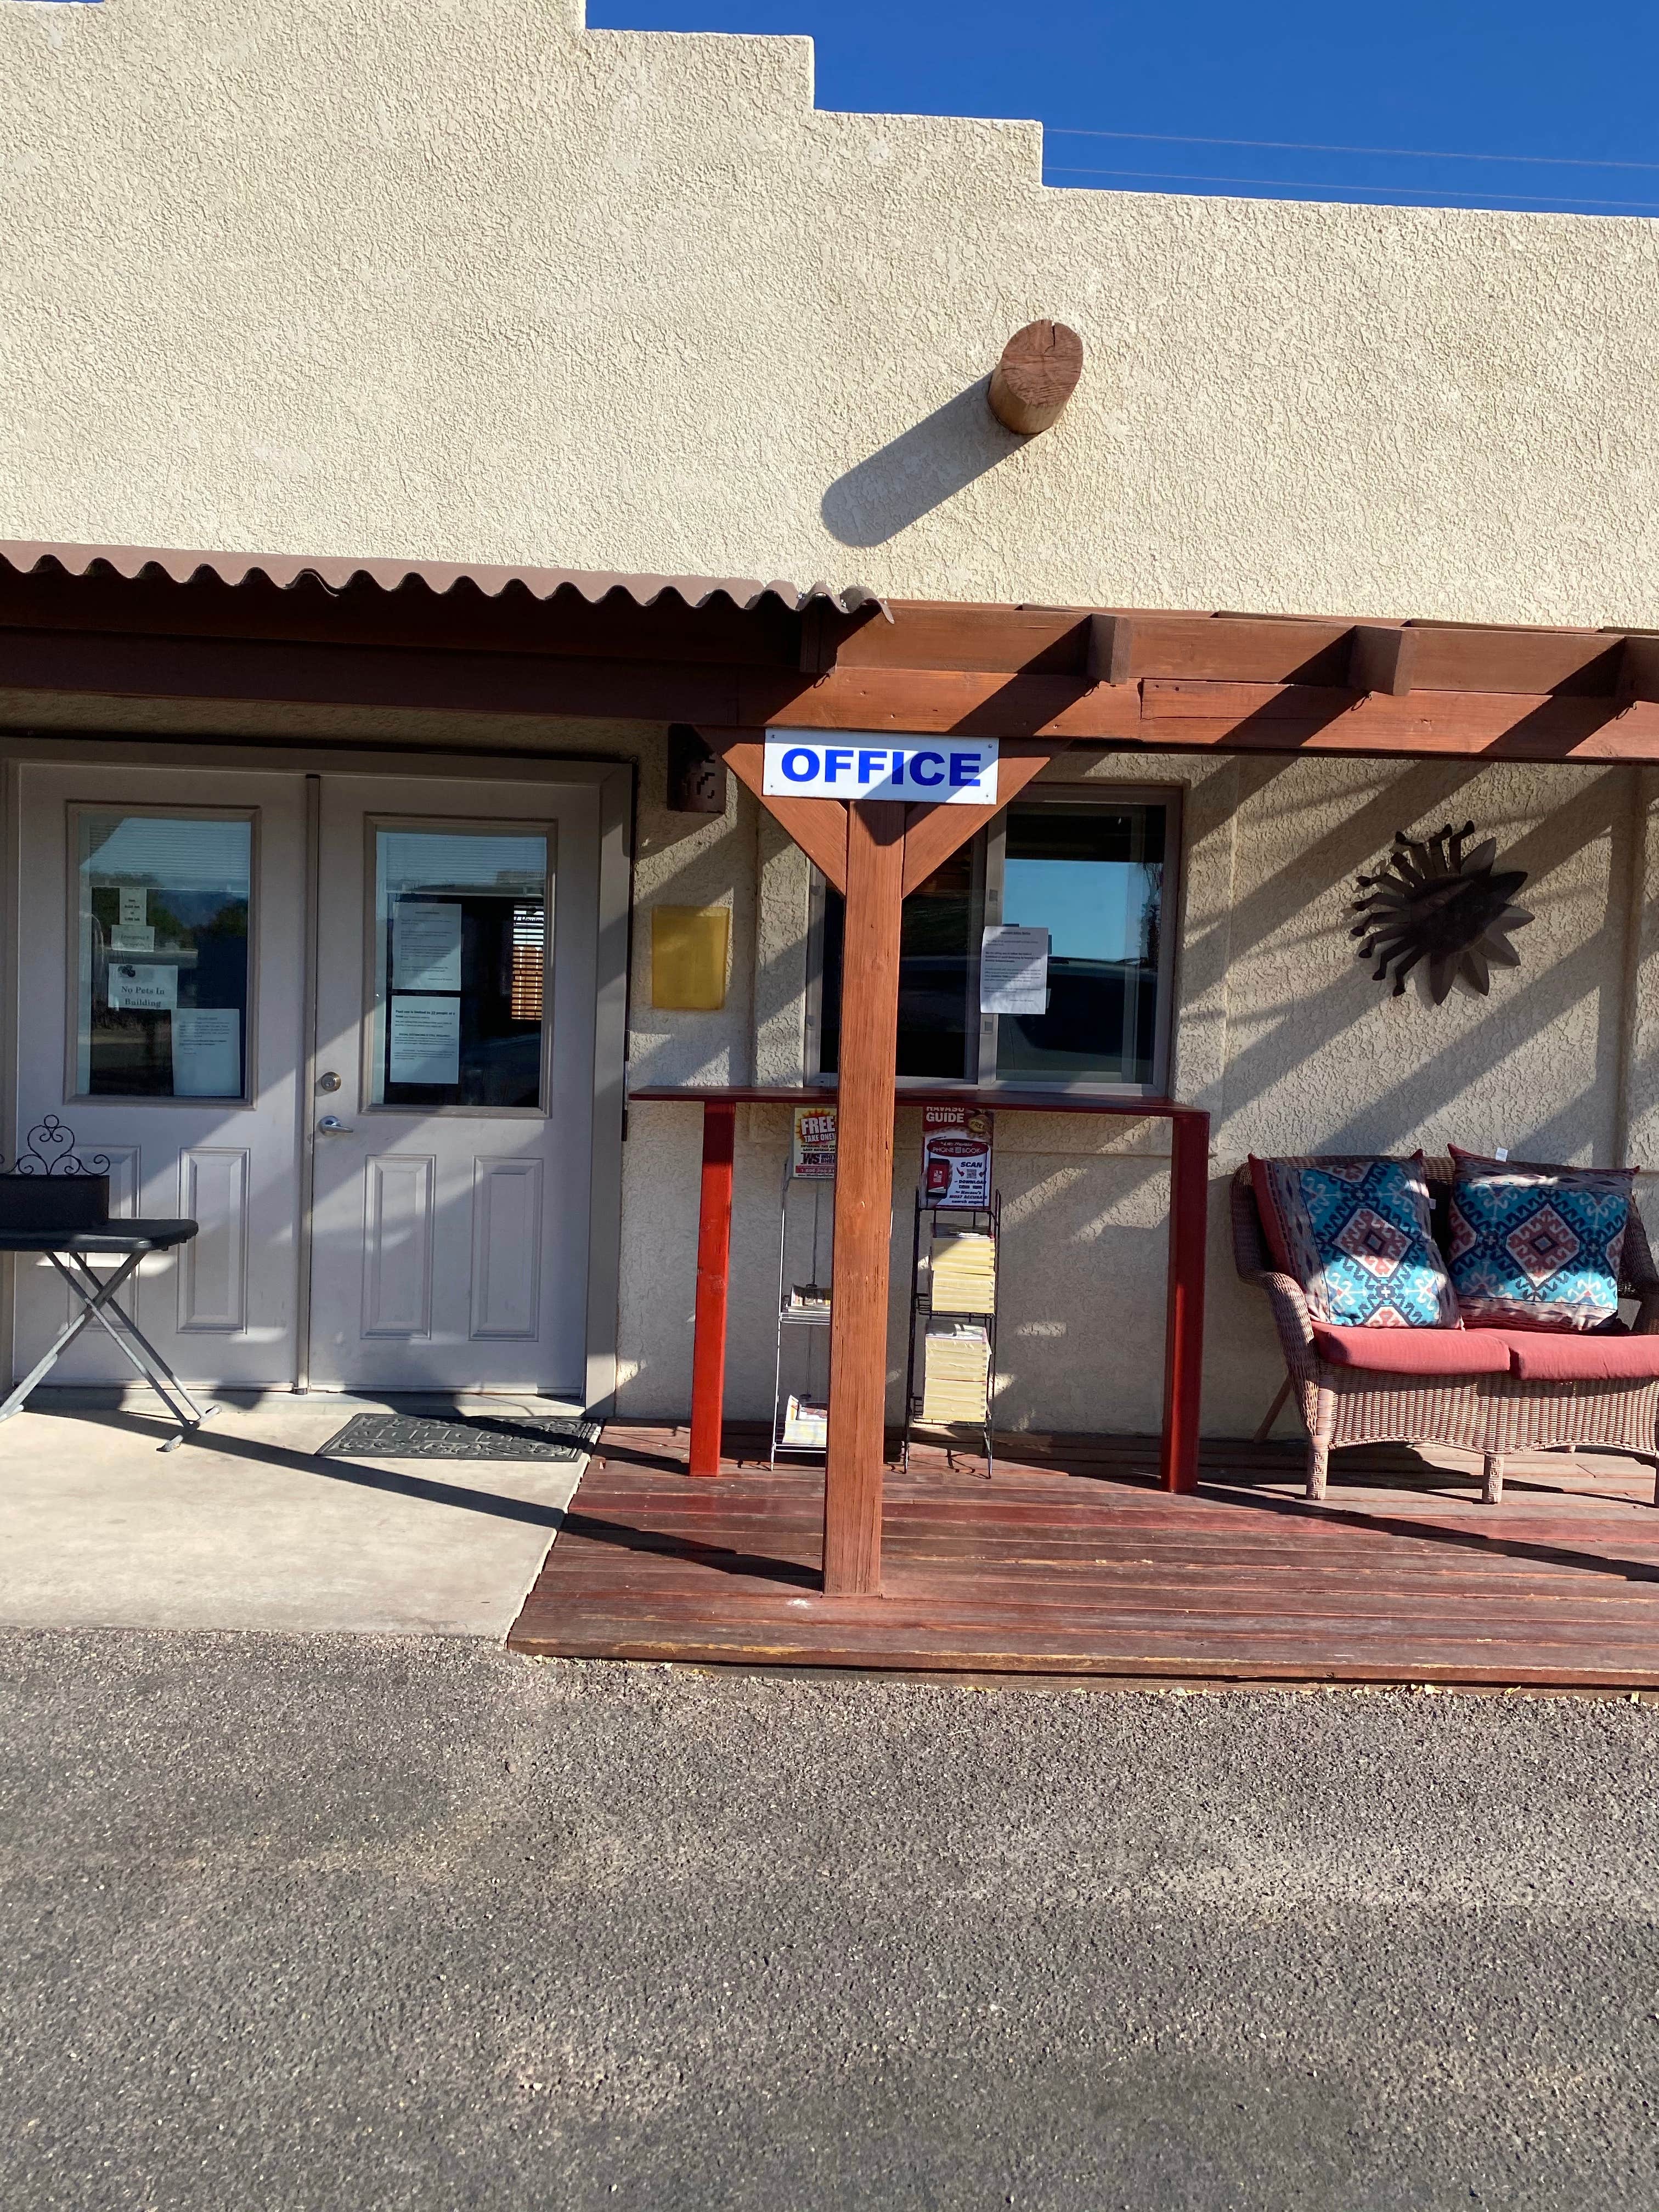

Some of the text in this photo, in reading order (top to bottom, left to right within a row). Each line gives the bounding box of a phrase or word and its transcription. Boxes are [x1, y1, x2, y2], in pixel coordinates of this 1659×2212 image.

[781, 748, 981, 787] OFFICE
[125, 998, 161, 1008] Building
[926, 1112, 964, 1123] GUIDE
[801, 1115, 836, 1135] FREE
[804, 1134, 820, 1143] TAKE
